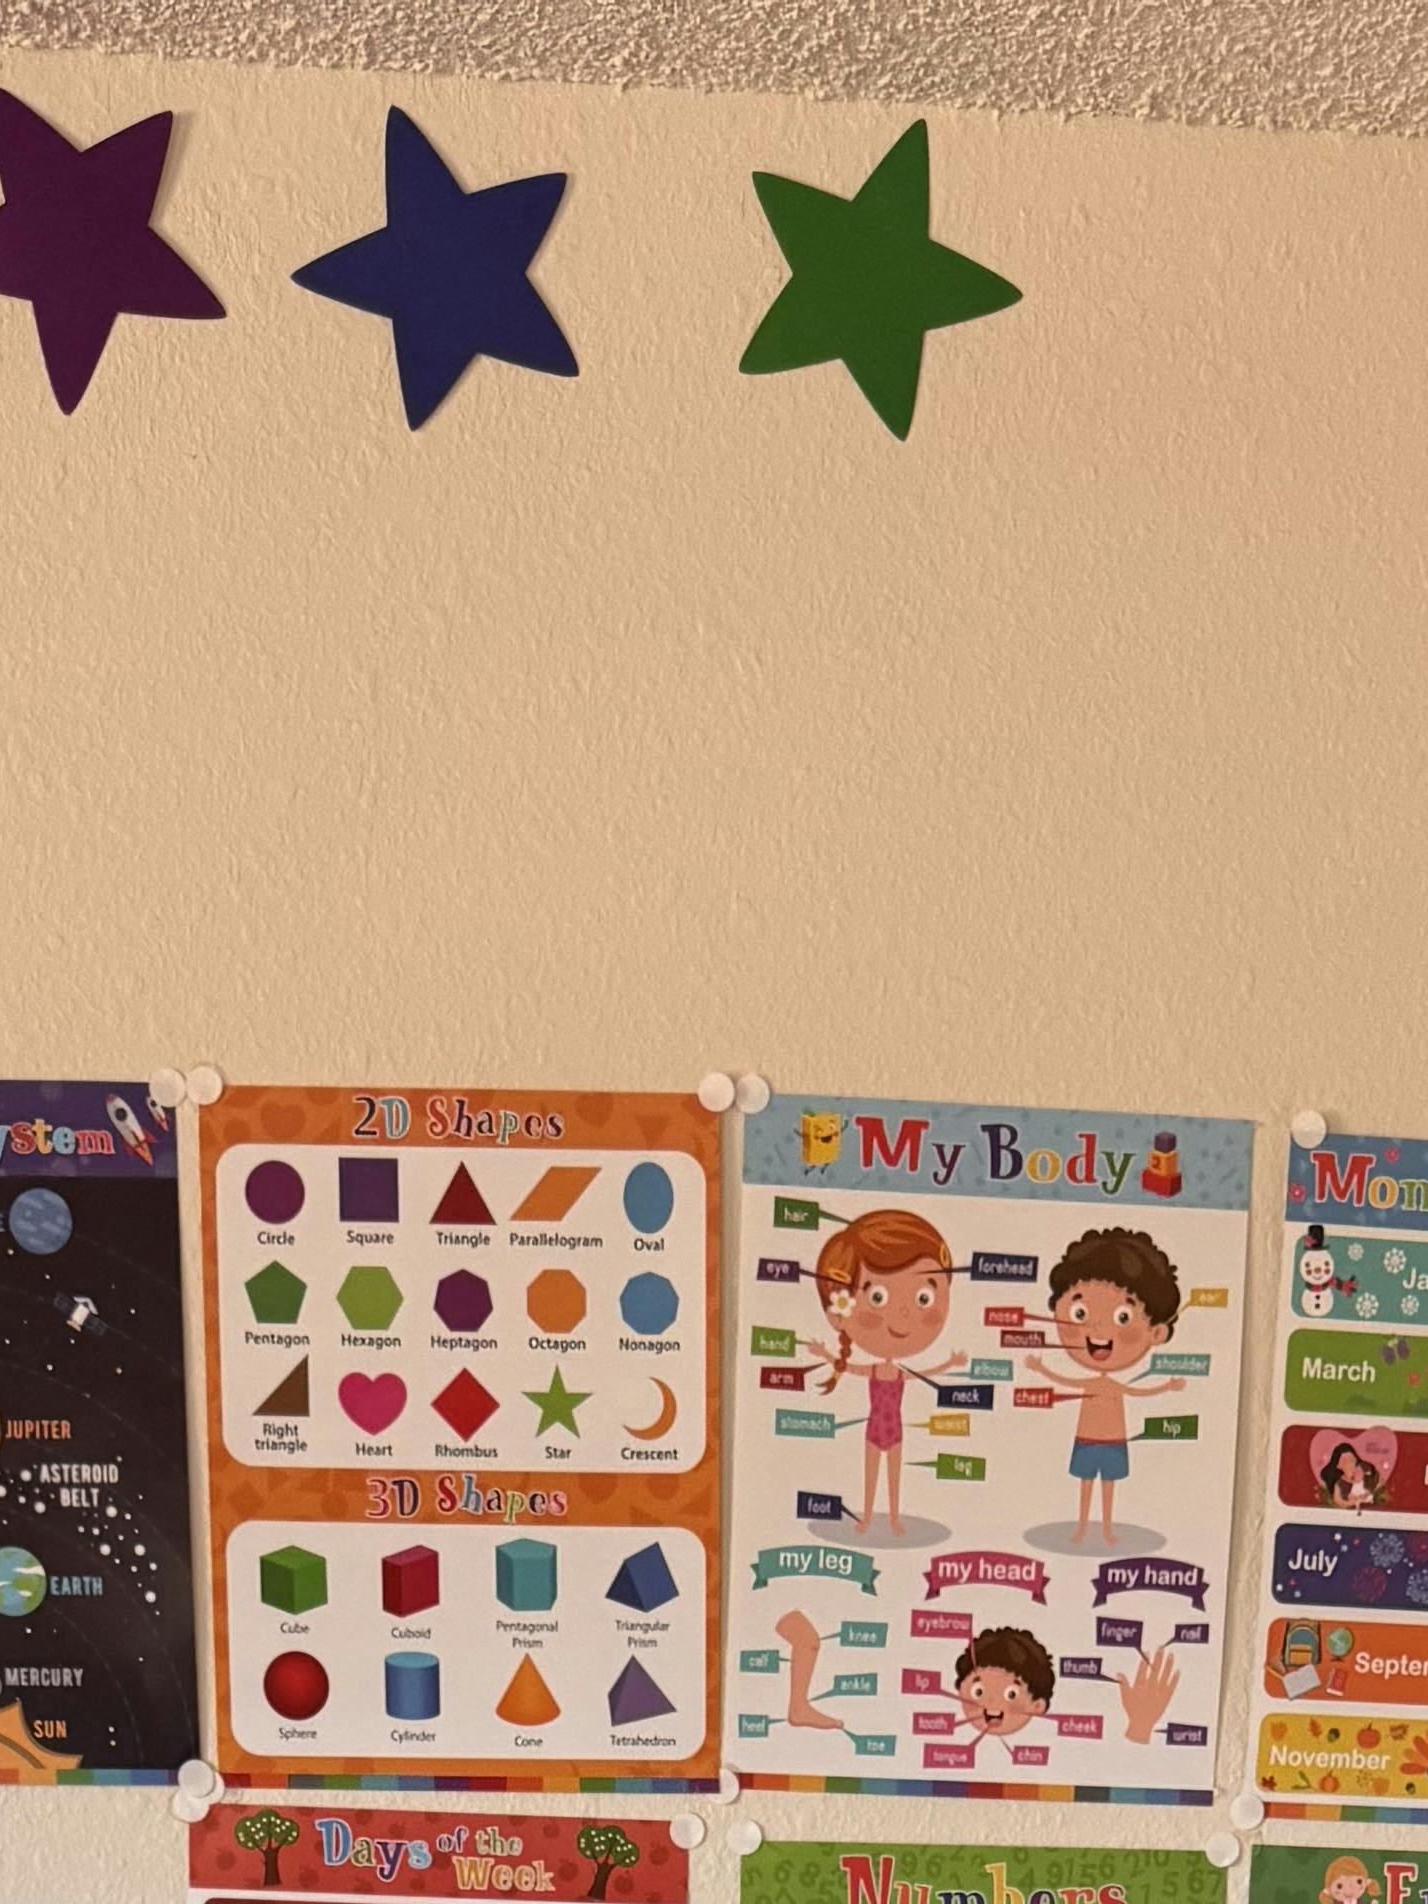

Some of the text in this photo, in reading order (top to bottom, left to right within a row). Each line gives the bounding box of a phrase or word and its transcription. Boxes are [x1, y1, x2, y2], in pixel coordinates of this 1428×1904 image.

[353, 1096, 565, 1145] 2D Shapes
[855, 1115, 1136, 1195] My Body
[784, 1207, 809, 1223] hair
[257, 1231, 295, 1246] Circle
[346, 1231, 394, 1247] Square
[437, 1232, 490, 1247] Triangle
[510, 1232, 603, 1249] Parallelogram
[633, 1237, 664, 1251] Oval
[767, 1262, 789, 1277] eye
[978, 1258, 1033, 1276] forehead
[245, 1332, 310, 1347] Pentagon
[341, 1334, 401, 1348] Hexagon
[528, 1337, 586, 1352] Octagon
[1156, 1356, 1208, 1372] shoulder
[1302, 1357, 1376, 1382] March
[6, 1420, 71, 1439] JUPITER
[780, 1417, 831, 1432] stomach
[1162, 1420, 1181, 1436] hip
[356, 1442, 392, 1457] Heart
[435, 1444, 498, 1458] Rhombus
[545, 1445, 572, 1459] Star
[621, 1447, 678, 1460] Crescent
[40, 1464, 119, 1484] ASTEROID
[61, 1488, 98, 1507] BELT
[365, 1474, 567, 1523] 3D Shapes
[779, 1548, 853, 1575] my leg
[1287, 1548, 1338, 1576] July
[938, 1558, 1036, 1582] my head
[1107, 1566, 1198, 1588] my hand
[51, 1576, 103, 1596] EARTH
[280, 1622, 310, 1635] Cube
[391, 1626, 431, 1640] Cuboid
[1102, 1622, 1137, 1640] finger
[1063, 1659, 1098, 1675] thumb
[5, 1668, 83, 1687] MERCURY
[34, 1721, 67, 1739] SUN
[278, 1727, 318, 1742] Sphere
[391, 1729, 436, 1744] Cylinder
[514, 1735, 543, 1748] Cone
[1269, 1745, 1391, 1770] November
[315, 1817, 523, 1881] Days of the
[453, 1856, 555, 1892] Week
